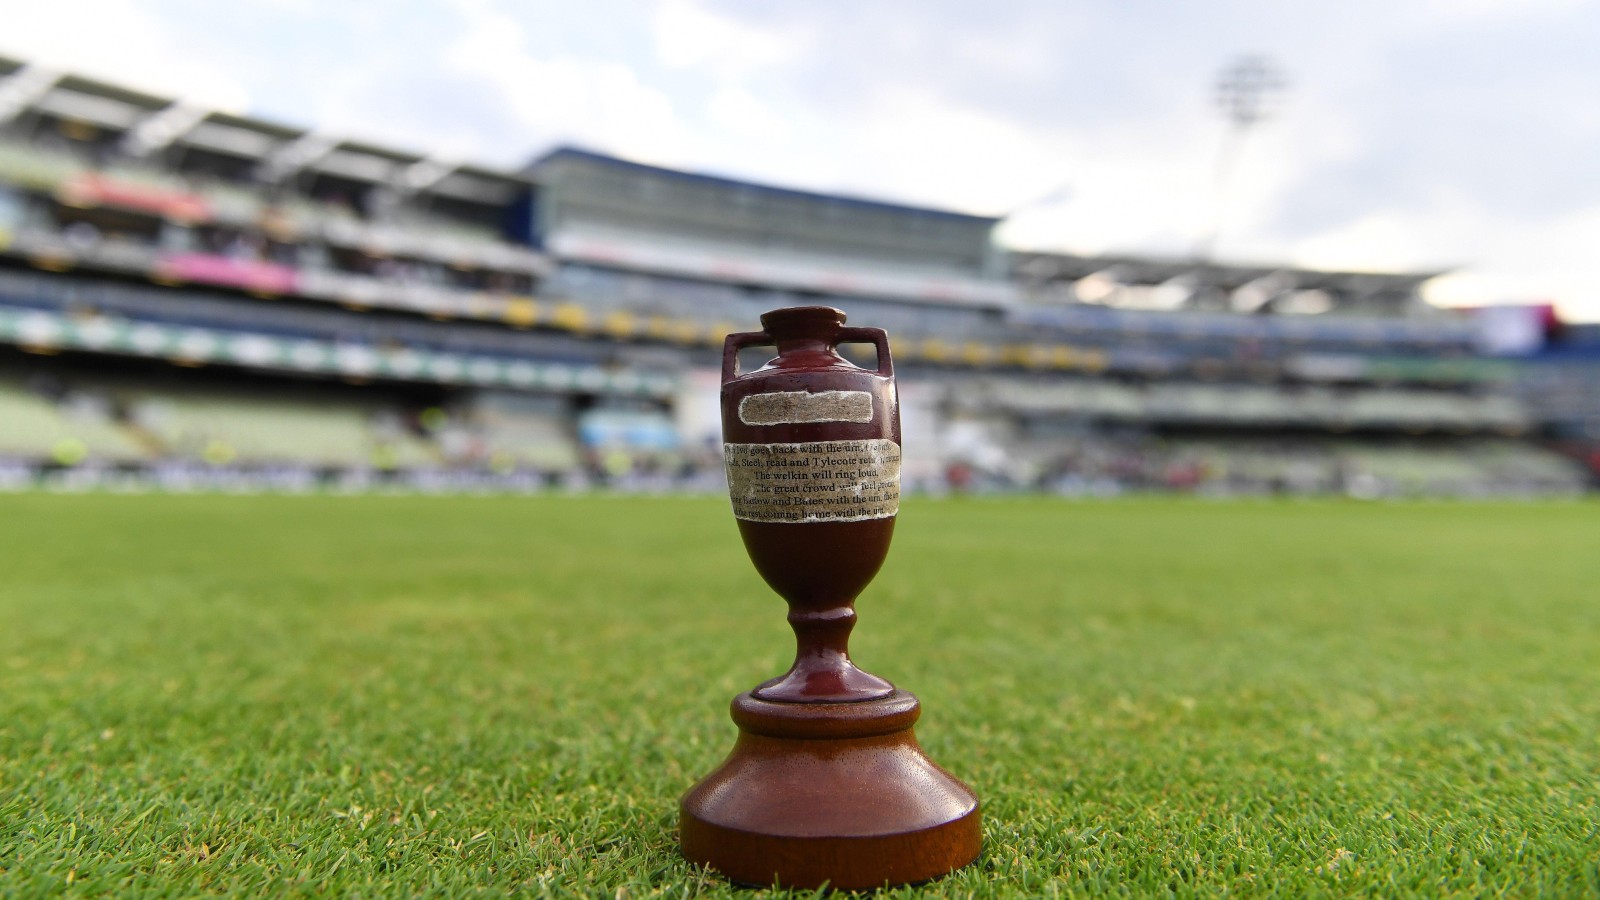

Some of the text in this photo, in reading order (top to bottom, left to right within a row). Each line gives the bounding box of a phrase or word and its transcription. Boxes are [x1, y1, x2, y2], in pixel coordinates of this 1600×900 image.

[750, 447, 770, 456] goes
[772, 445, 797, 454] back
[799, 443, 823, 453] with
[825, 443, 842, 453] the
[766, 458, 787, 467] read
[789, 457, 810, 466] and
[812, 456, 857, 468] Tylecote
[754, 470, 771, 480] The
[772, 470, 809, 480] welkin
[811, 469, 832, 480] will
[834, 469, 856, 480] ring
[774, 485, 800, 494] great
[802, 483, 836, 493] crowd
[772, 496, 792, 506] and
[794, 496, 824, 506] Bates
[826, 495, 850, 505] with
[852, 495, 867, 504] the
[763, 509, 799, 521] coming
[801, 509, 832, 519] home
[833, 508, 856, 518] with
[858, 508, 872, 516] the
